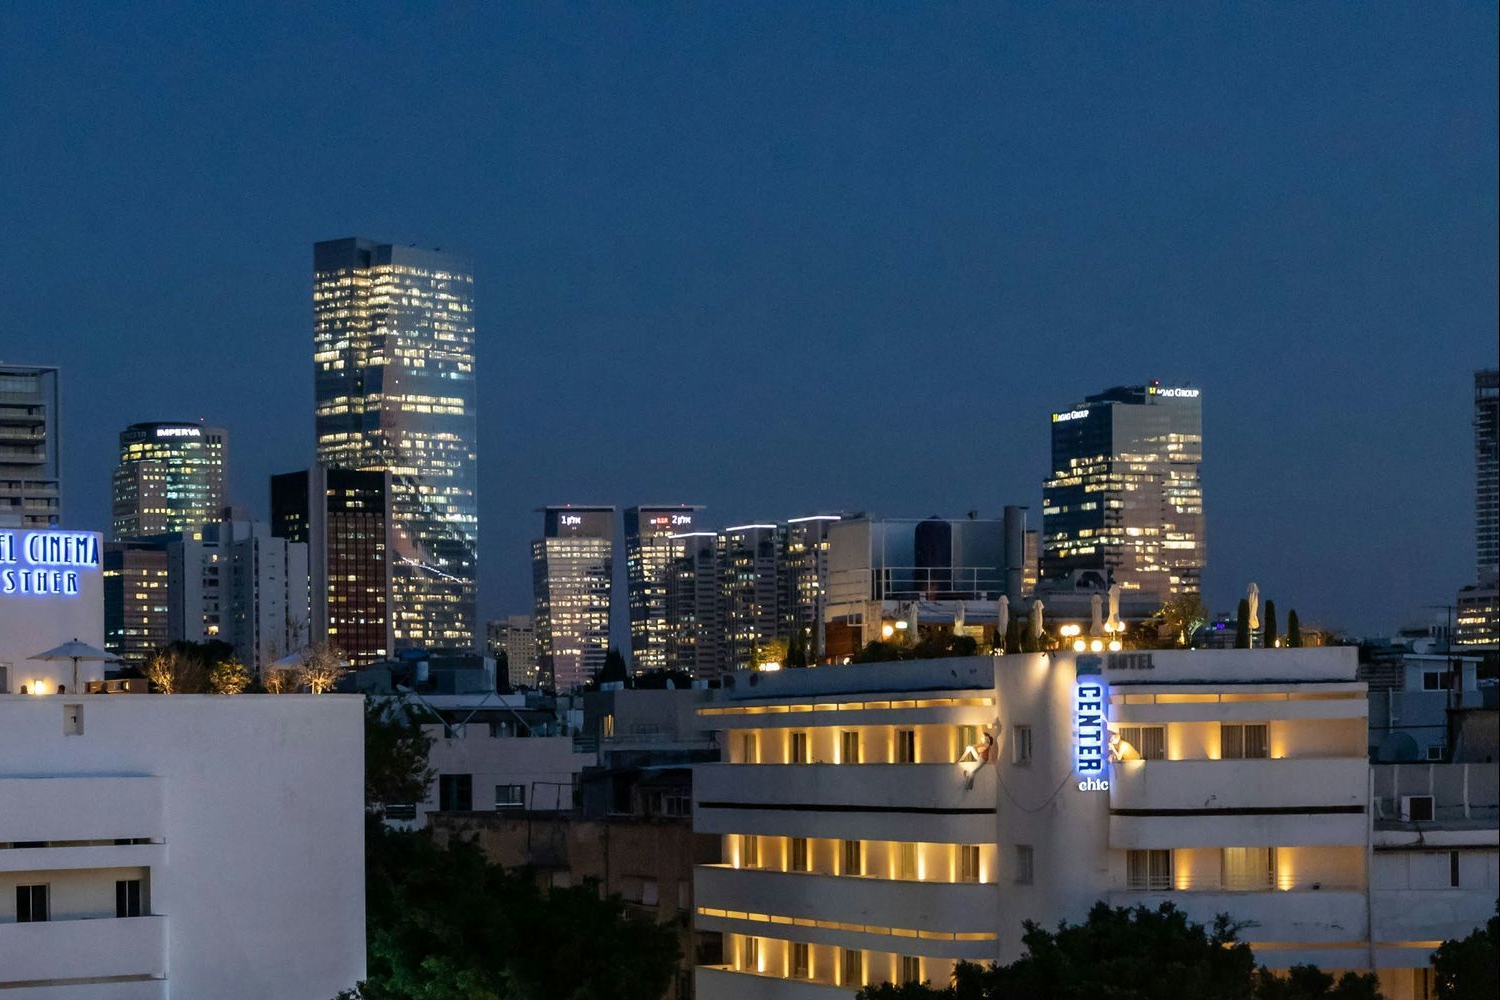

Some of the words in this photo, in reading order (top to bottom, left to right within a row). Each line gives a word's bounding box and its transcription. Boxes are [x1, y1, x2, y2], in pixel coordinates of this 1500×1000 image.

[156, 428, 200, 437] IMPERVA
[29, 534, 100, 565] CINEMA
[1078, 686, 1102, 772] CENTER
[1078, 777, 1109, 791] chic
